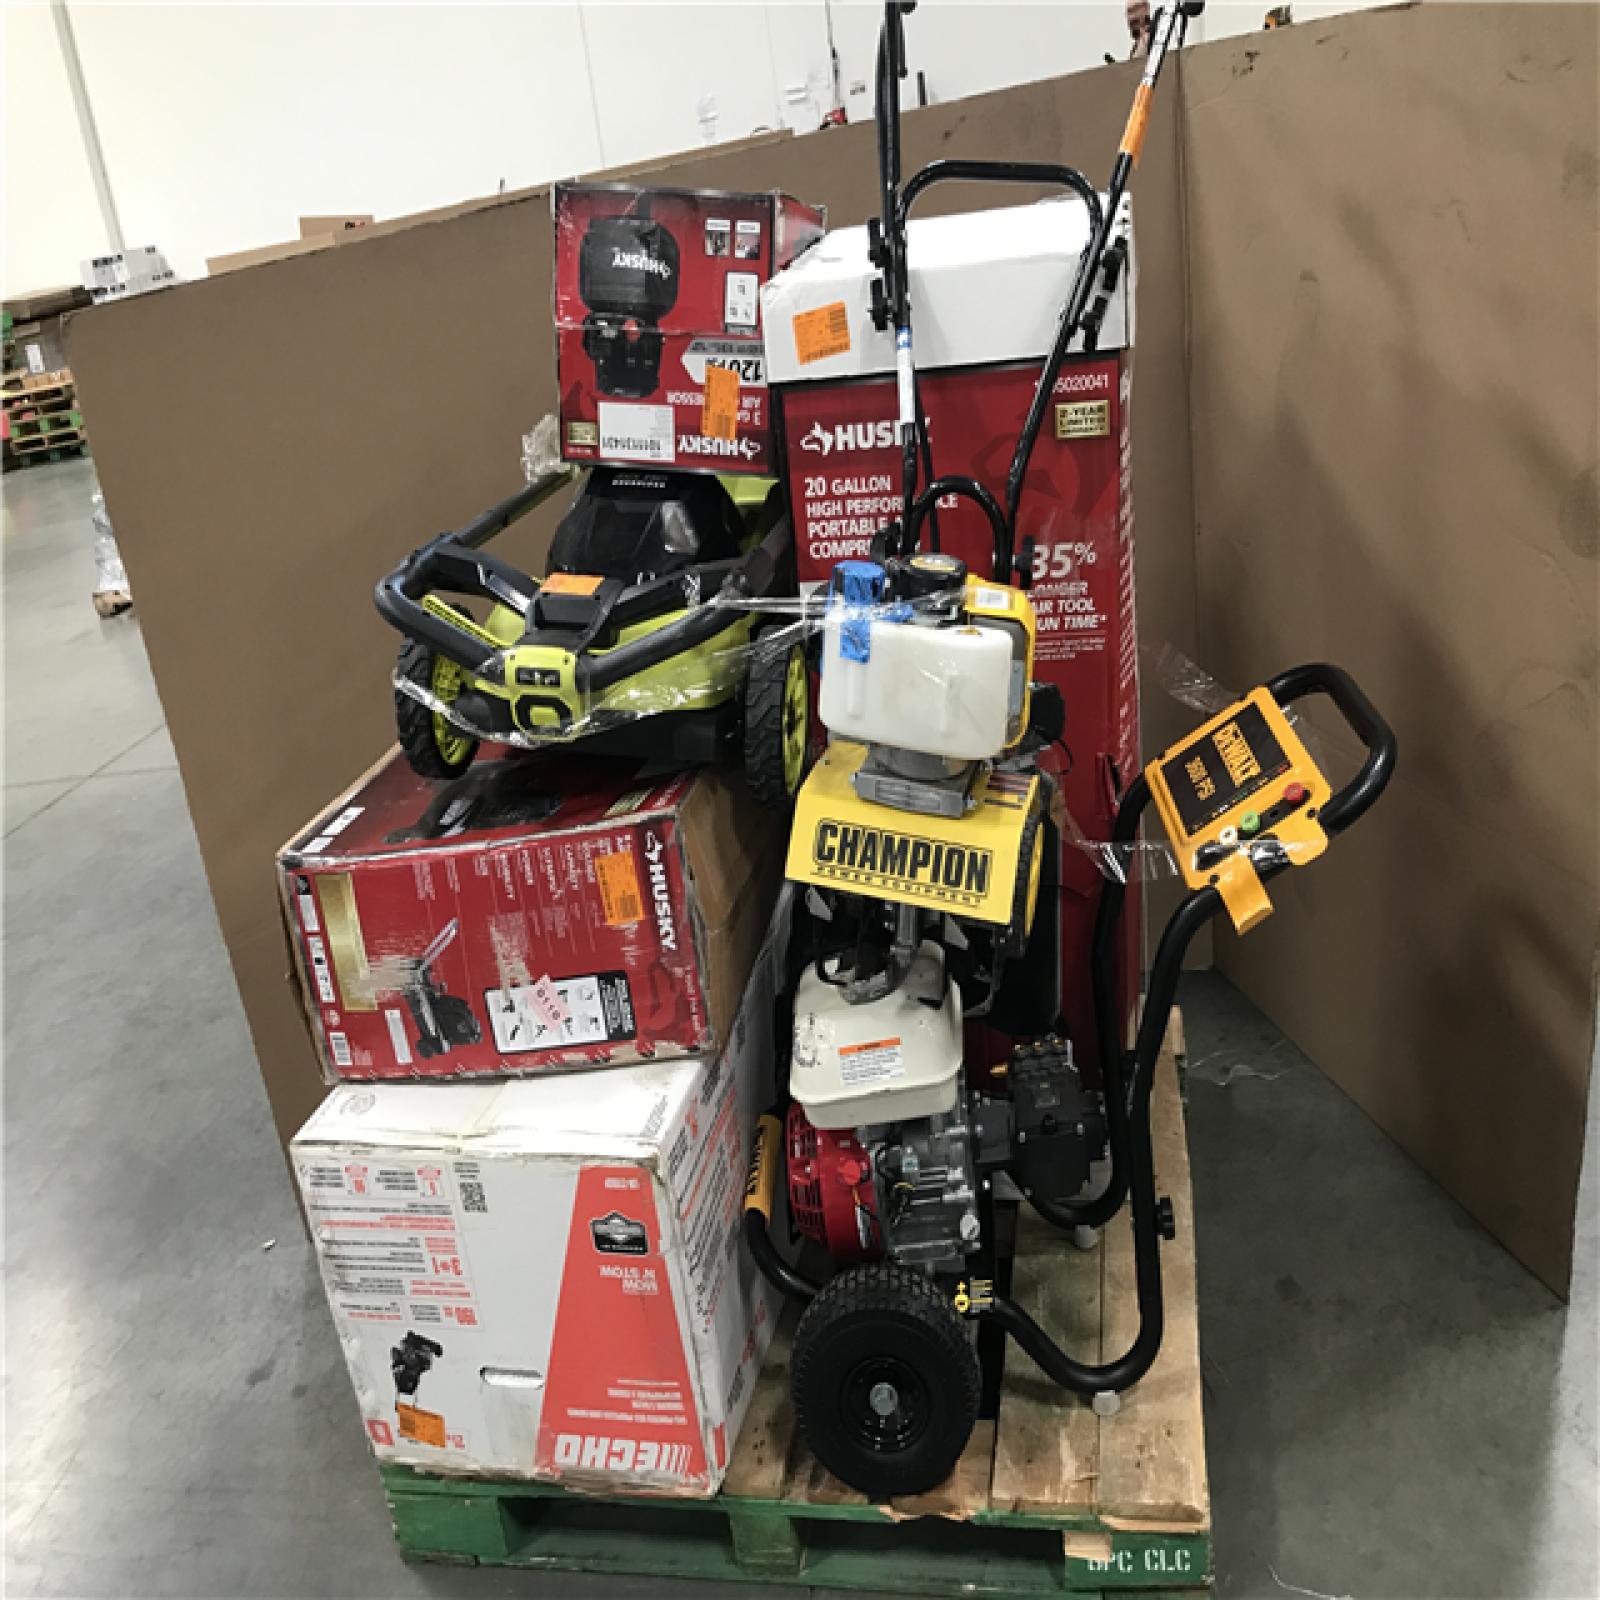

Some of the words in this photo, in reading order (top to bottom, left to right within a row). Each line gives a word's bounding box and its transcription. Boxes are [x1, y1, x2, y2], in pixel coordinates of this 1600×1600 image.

[677, 434, 739, 457] HUSKY
[804, 476, 826, 498] 20
[831, 474, 891, 496] GALLON
[807, 499, 843, 520] HIGH
[1056, 597, 1096, 615] TOOL
[815, 819, 992, 898] CHAMPION
[648, 863, 678, 951] HUSKY
[554, 1434, 659, 1471] ECHO
[1144, 1549, 1191, 1572] CLC
